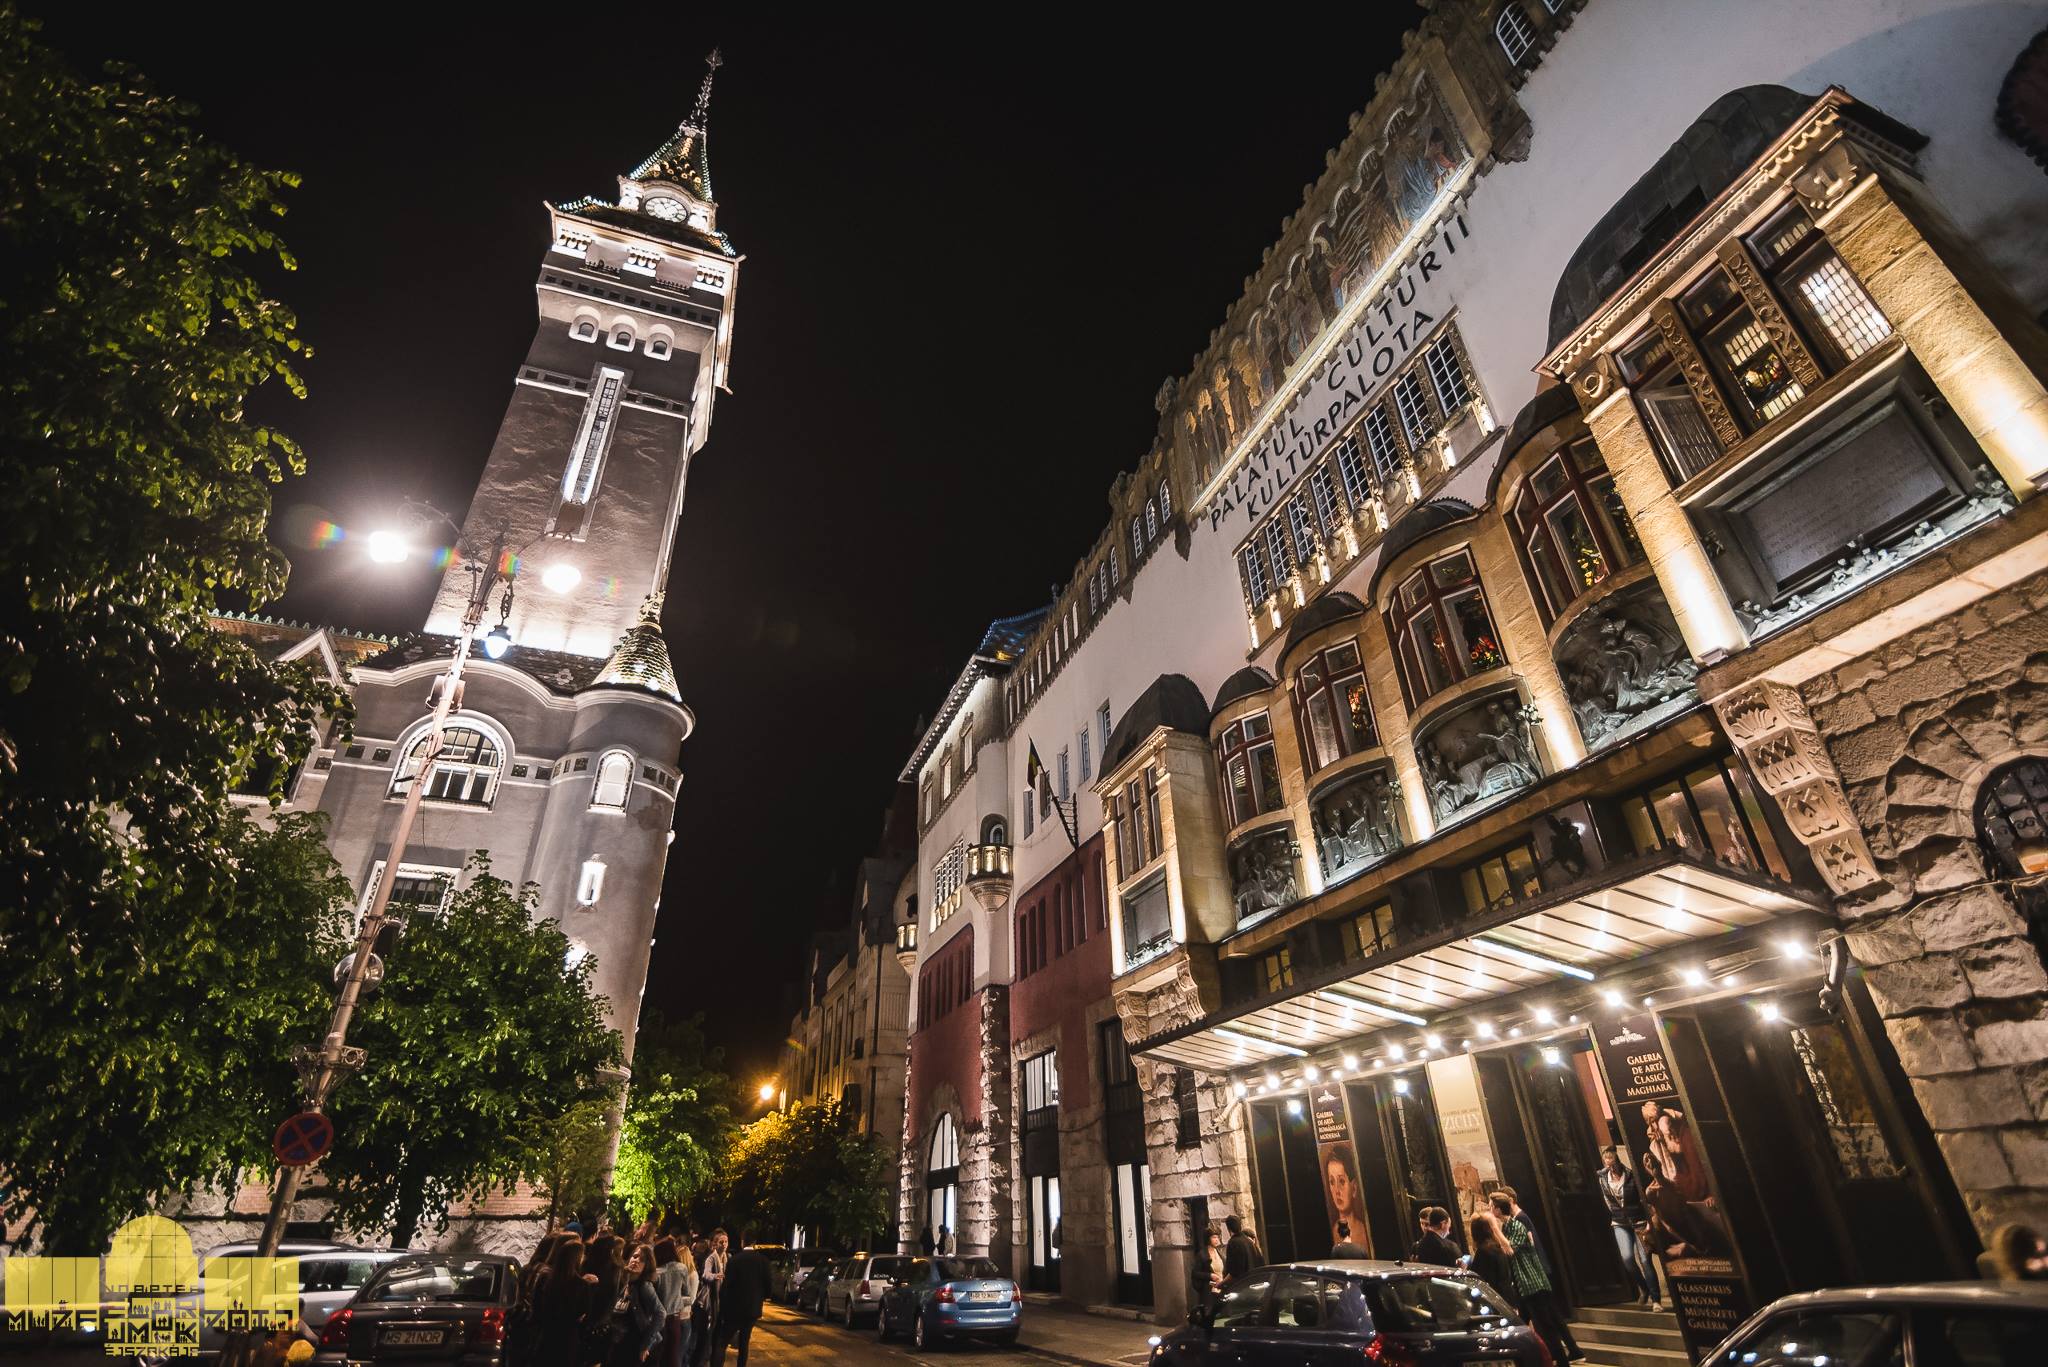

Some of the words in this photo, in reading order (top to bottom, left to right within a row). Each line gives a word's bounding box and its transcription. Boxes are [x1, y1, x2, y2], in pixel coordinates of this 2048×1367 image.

[1211, 416, 1306, 532] PALATUL
[1327, 214, 1470, 391] CULTURII
[1626, 1052, 1663, 1066] GALERIA
[1632, 1066, 1645, 1075] DE
